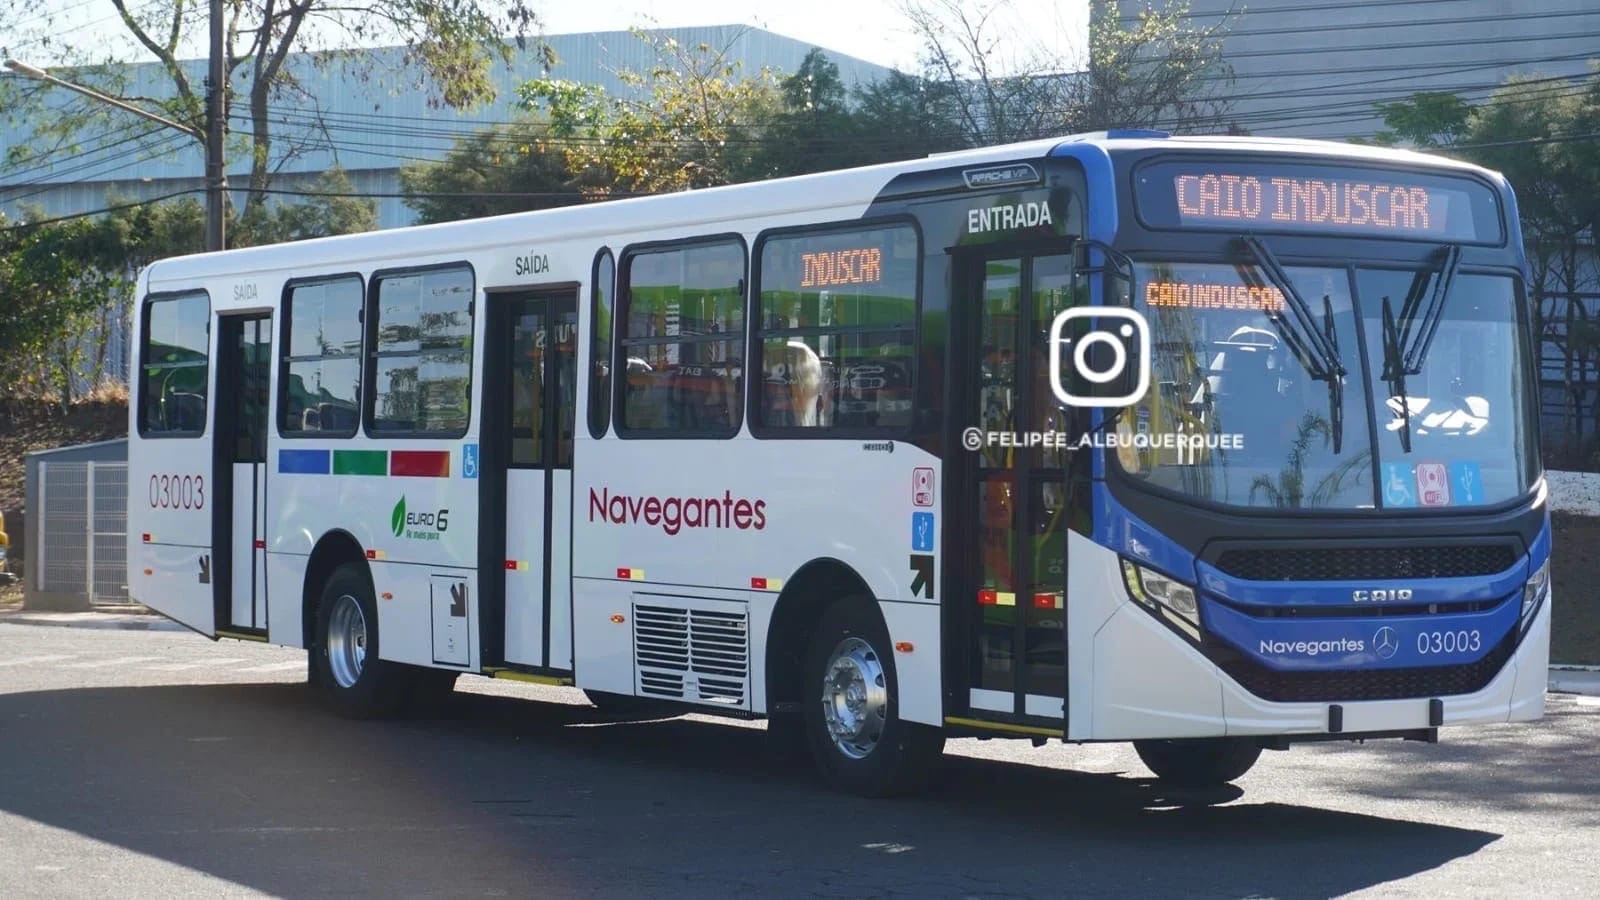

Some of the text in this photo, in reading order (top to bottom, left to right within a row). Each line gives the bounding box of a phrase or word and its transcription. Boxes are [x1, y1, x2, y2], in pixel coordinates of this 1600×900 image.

[1178, 174, 1429, 229] CAIO INDUSCAR
[968, 201, 1052, 233] ENTRADA
[515, 249, 550, 276] SAÍDA
[801, 248, 880, 287] INDUSCAR
[1146, 282, 1285, 311] CAIO INDUSCAR
[149, 474, 204, 510] 03003
[406, 509, 449, 532] EURO 6
[589, 486, 766, 536] Navegantes
[1353, 588, 1413, 602] CAIO
[1260, 638, 1365, 655] Navegantes
[1417, 630, 1481, 654] 03003
